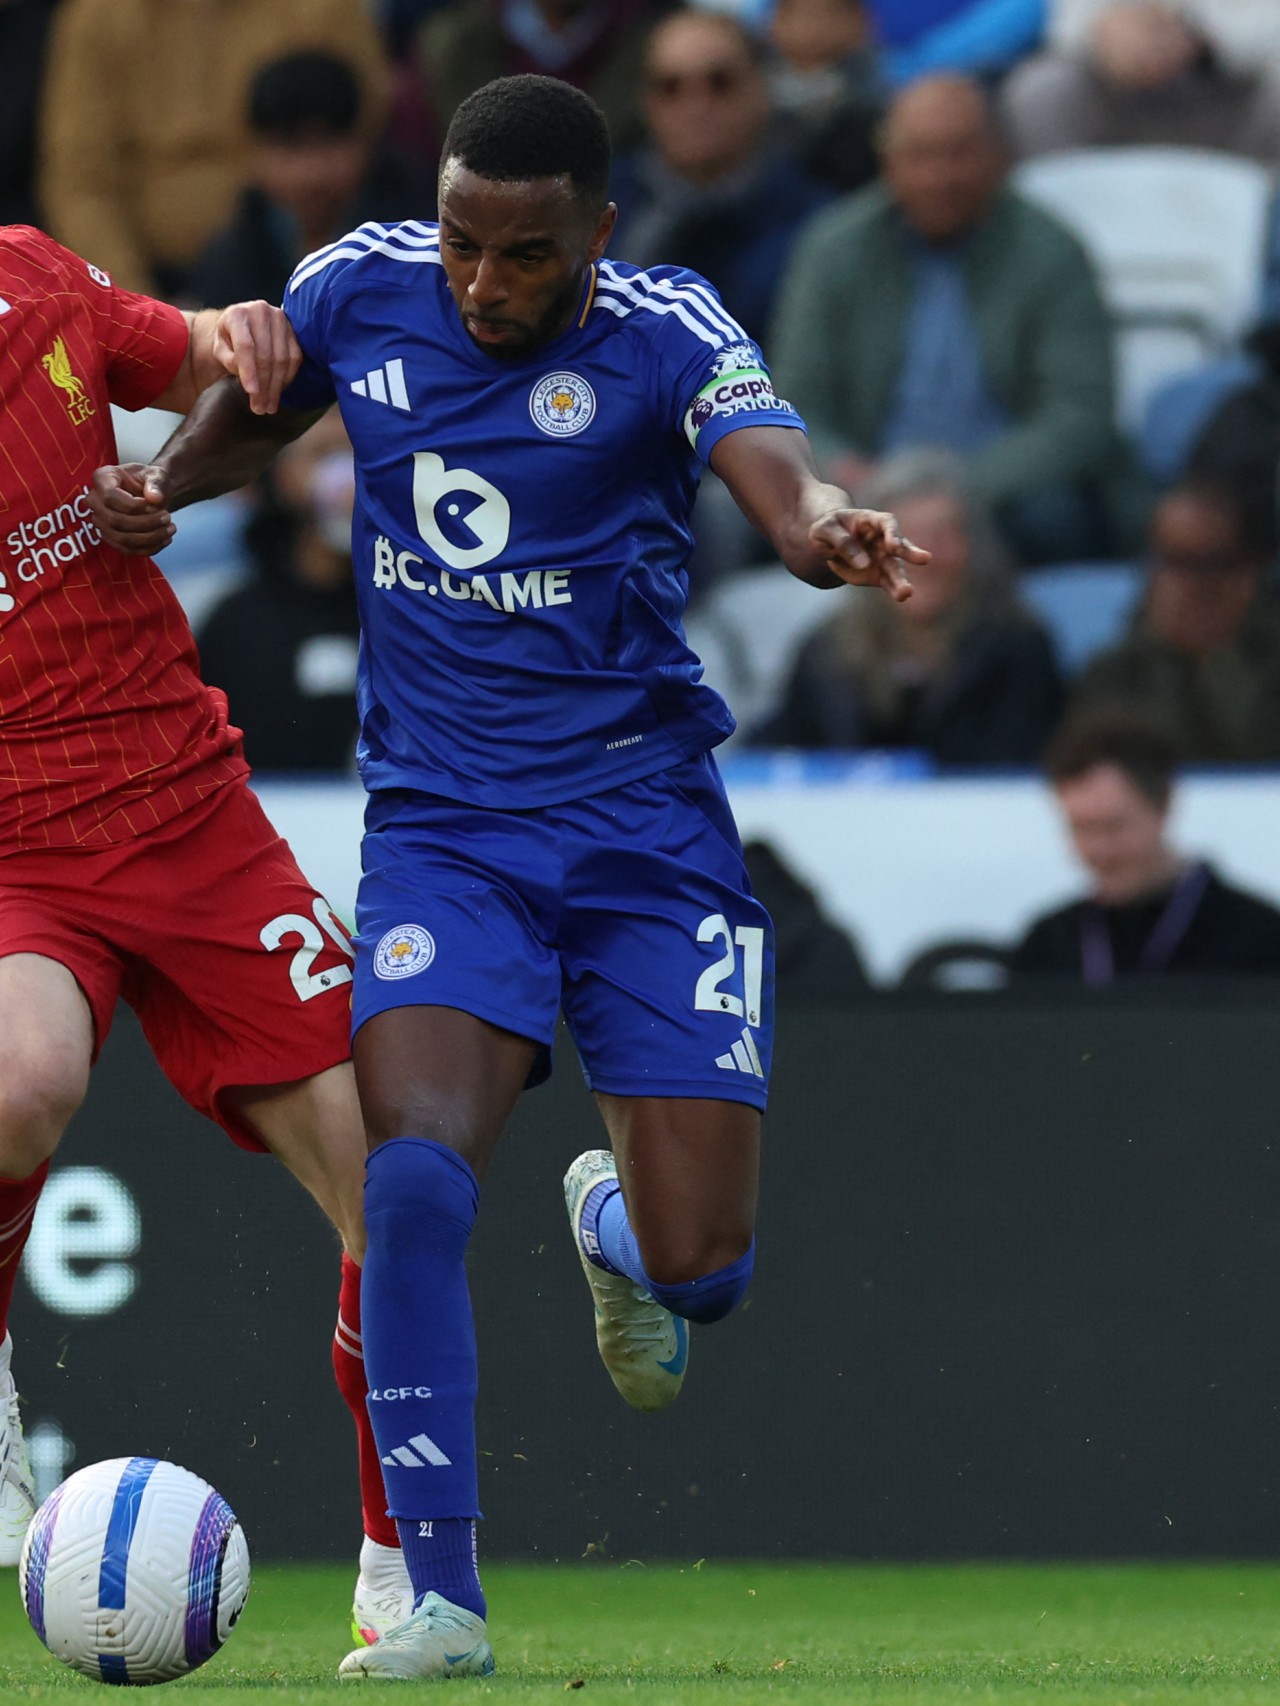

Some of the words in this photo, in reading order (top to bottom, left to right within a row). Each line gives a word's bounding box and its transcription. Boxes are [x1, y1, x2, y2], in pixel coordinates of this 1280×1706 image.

[536, 377, 578, 401] LEICESTER
[577, 384, 590, 404] CITY
[535, 405, 572, 431] FOOTBALL
[571, 407, 589, 428] CLUB
[416, 933, 429, 950] CITY
[694, 913, 764, 1028] 21
[371, 1386, 433, 1401] LCFC
[418, 1521, 434, 1538] 21
